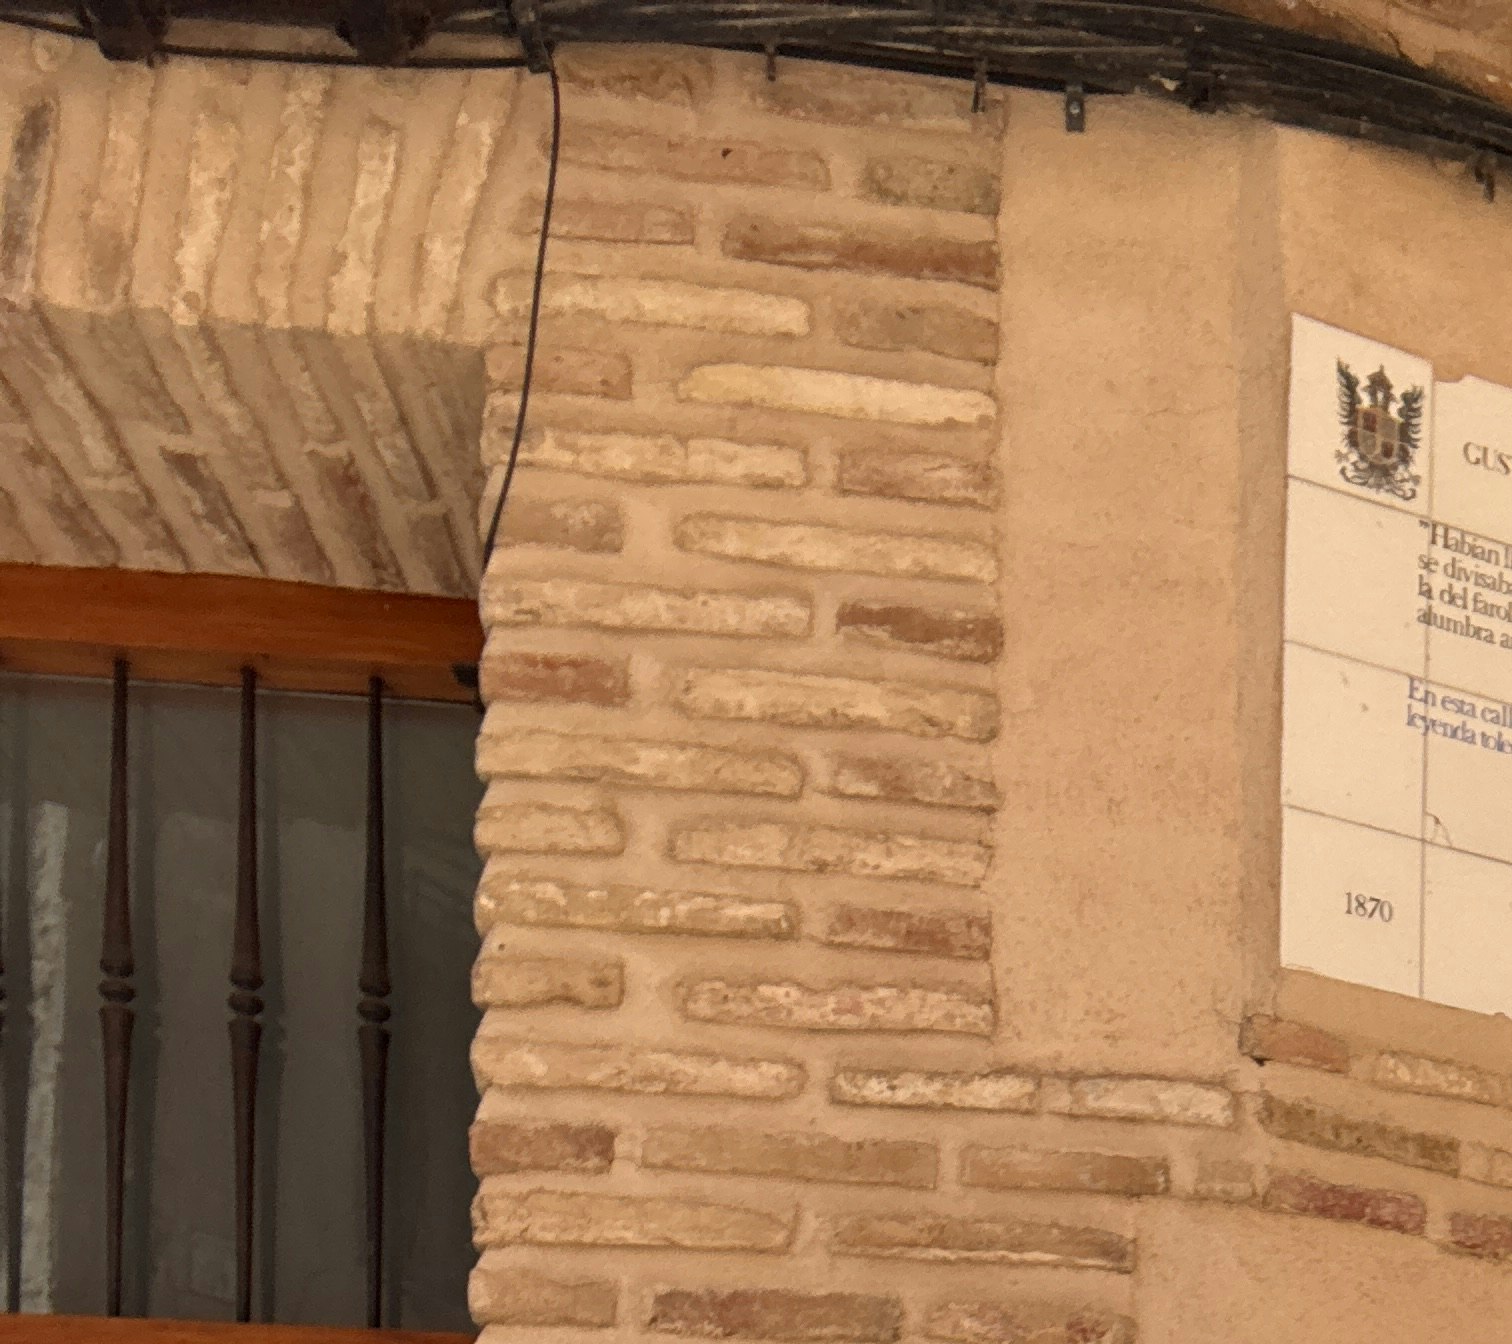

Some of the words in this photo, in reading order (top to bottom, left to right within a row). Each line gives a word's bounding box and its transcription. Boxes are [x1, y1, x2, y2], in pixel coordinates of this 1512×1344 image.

[1418, 553, 1439, 574] se
[1418, 573, 1434, 601] la
[1440, 583, 1468, 610] del
[1417, 604, 1496, 645] alumbra
[1408, 676, 1437, 707] En
[1441, 695, 1477, 719] esta
[1407, 703, 1477, 746] leyenda
[1344, 890, 1394, 923] 1870
